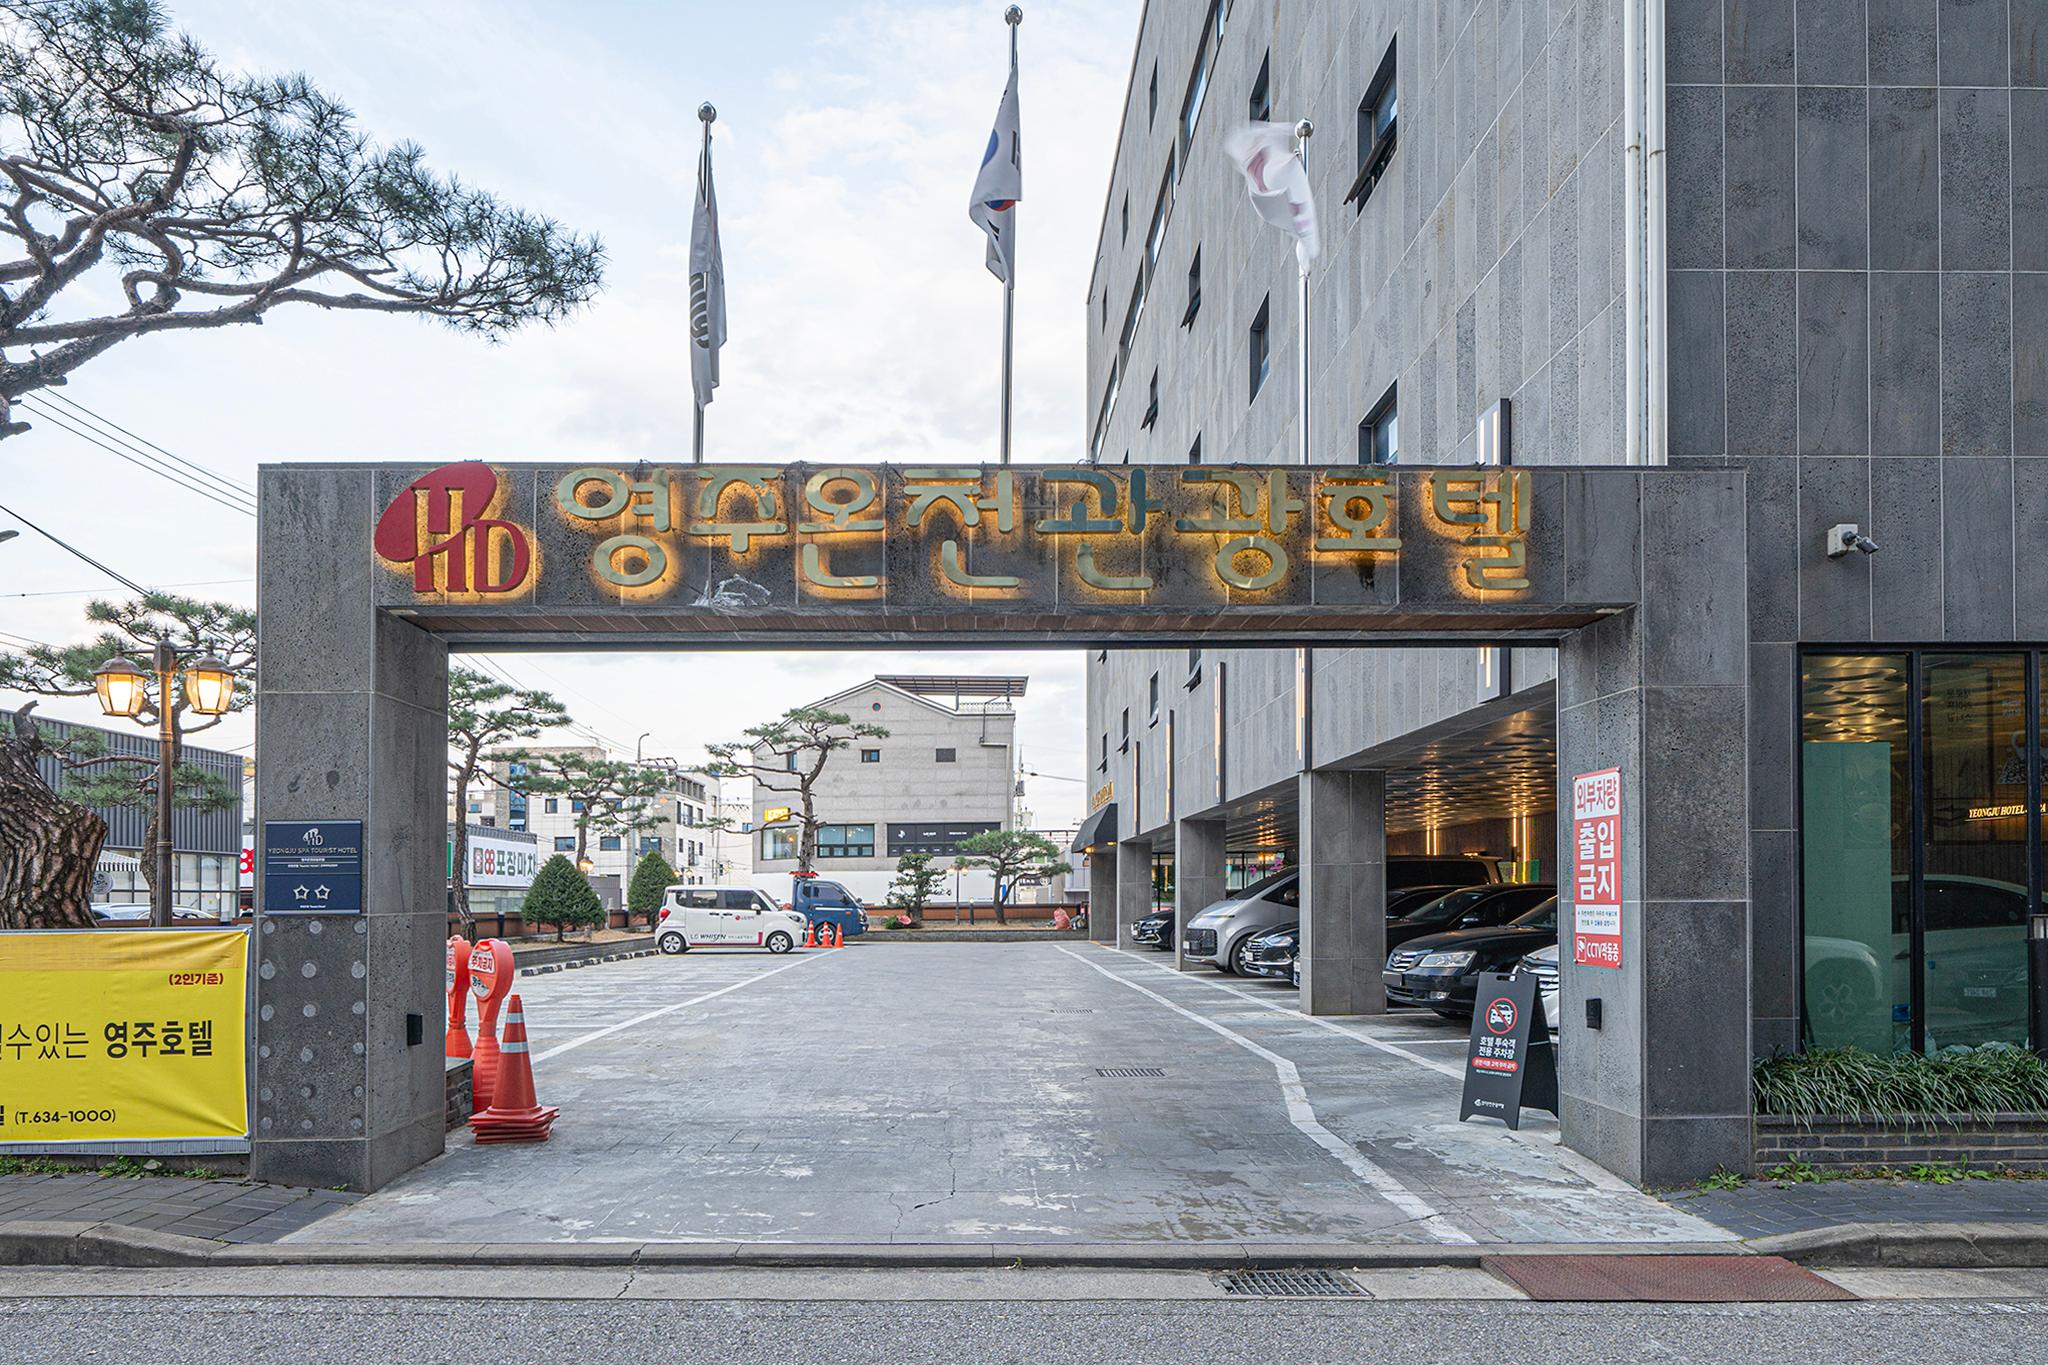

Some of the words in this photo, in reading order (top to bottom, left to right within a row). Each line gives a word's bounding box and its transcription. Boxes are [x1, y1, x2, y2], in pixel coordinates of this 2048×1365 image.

[1576, 777, 1617, 813] 외부차량
[1969, 807, 2000, 818] YEONGJU
[2000, 804, 2025, 816] HOTEL
[1578, 820, 1615, 860] 출입
[1578, 862, 1616, 900] 금지
[169, 973, 224, 985] (2인기준)
[0, 1022, 89, 1061] 수있는
[104, 1020, 213, 1059] 영주호텔
[15, 1109, 117, 1125] (T.634-1000)
